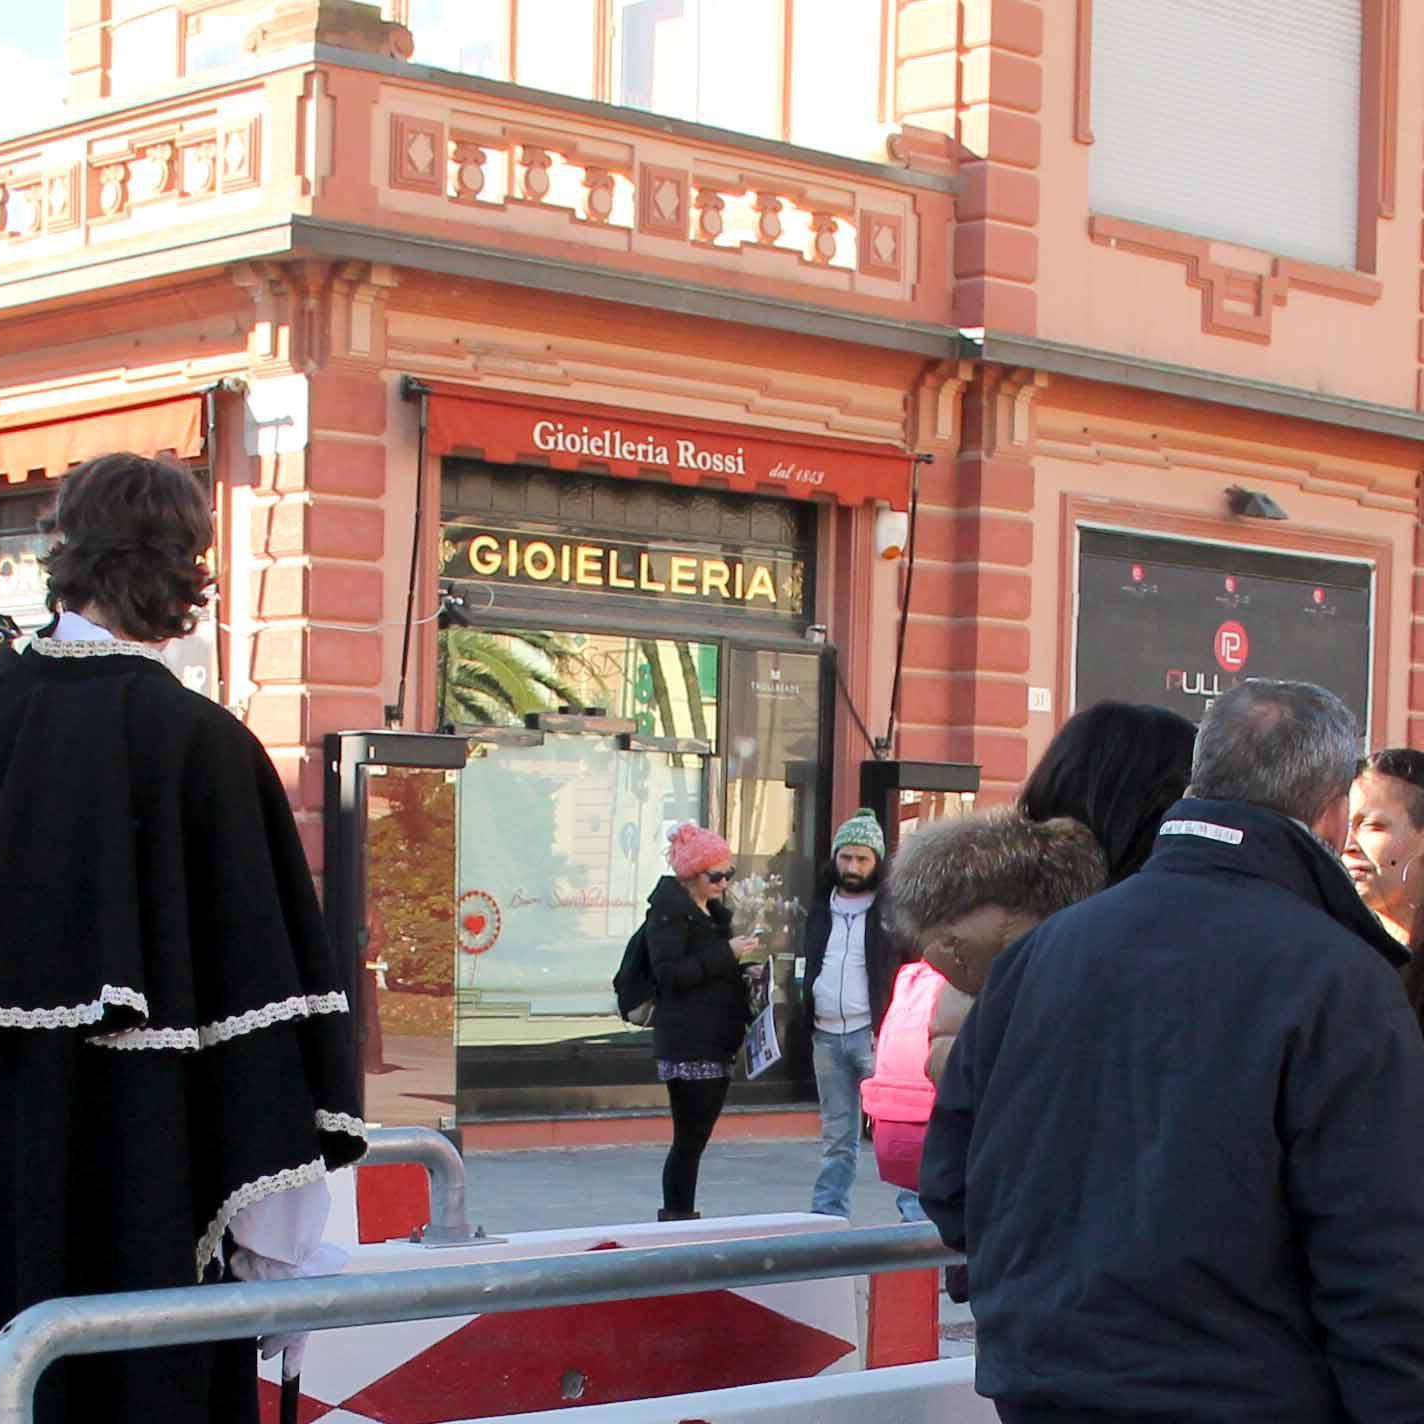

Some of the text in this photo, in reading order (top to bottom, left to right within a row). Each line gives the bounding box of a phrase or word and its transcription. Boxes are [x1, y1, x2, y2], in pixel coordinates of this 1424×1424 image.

[532, 421, 669, 465] Gioielleria
[677, 440, 745, 475] Rossi
[769, 461, 792, 479] dal
[468, 535, 777, 603] GIOIELLERIA
